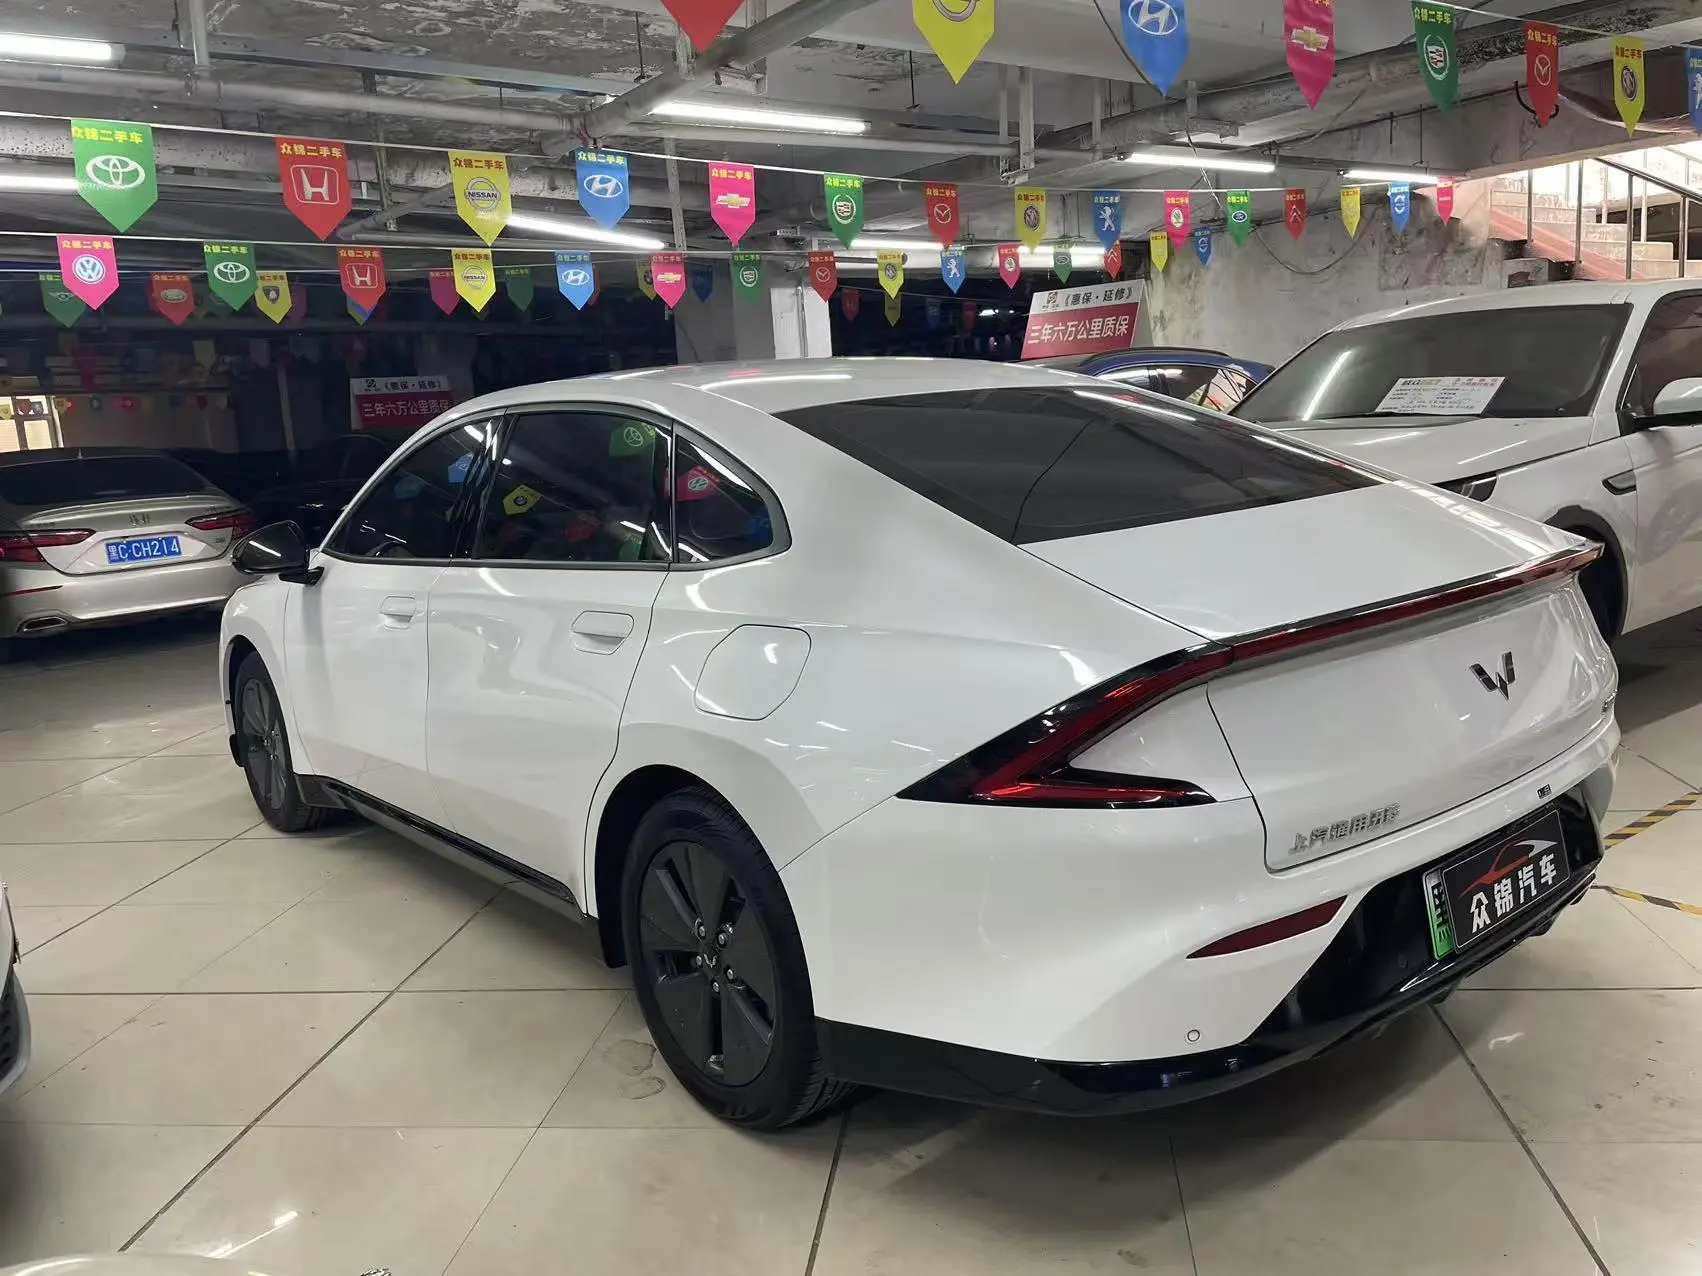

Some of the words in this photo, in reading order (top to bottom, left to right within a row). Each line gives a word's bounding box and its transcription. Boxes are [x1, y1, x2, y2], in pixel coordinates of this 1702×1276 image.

[71, 125, 144, 145] 众锦二手车
[280, 142, 343, 159] 众锦二手车
[452, 157, 505, 171] 众锦二手车
[577, 151, 625, 165] 众锦二手车
[711, 168, 752, 181] 众锦二手车
[826, 177, 861, 189] 众锦二手车
[467, 191, 498, 200] NISSAN
[61, 240, 112, 249] 众锦二手车
[203, 244, 248, 255] 众锦二手车
[463, 273, 486, 281] NISSAN
[1027, 315, 1130, 344] 三年六万公里质保
[1470, 853, 1558, 934] 众锦汽车
